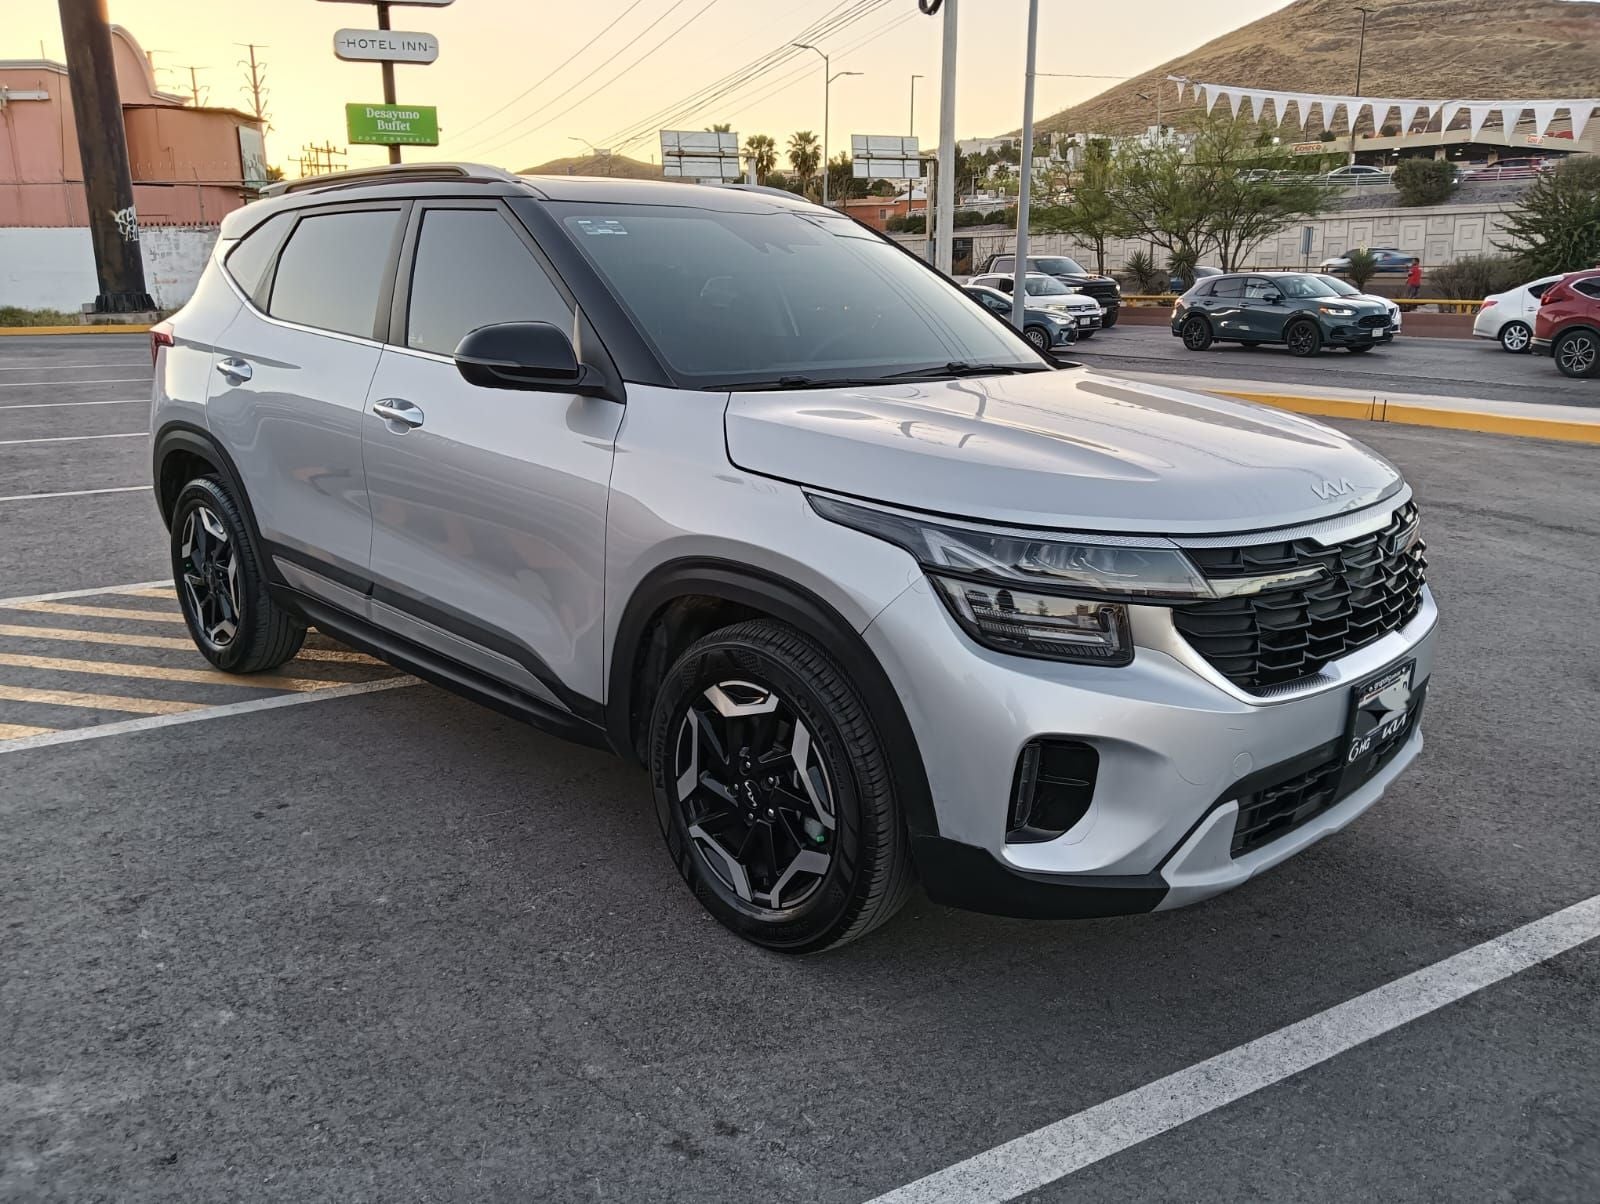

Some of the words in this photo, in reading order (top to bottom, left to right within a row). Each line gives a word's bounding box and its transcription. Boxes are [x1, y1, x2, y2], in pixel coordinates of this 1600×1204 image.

[346, 38, 397, 51] HOTEL
[401, 40, 428, 52] INN
[365, 107, 420, 121] Desayuno
[377, 119, 411, 131] Buffet
